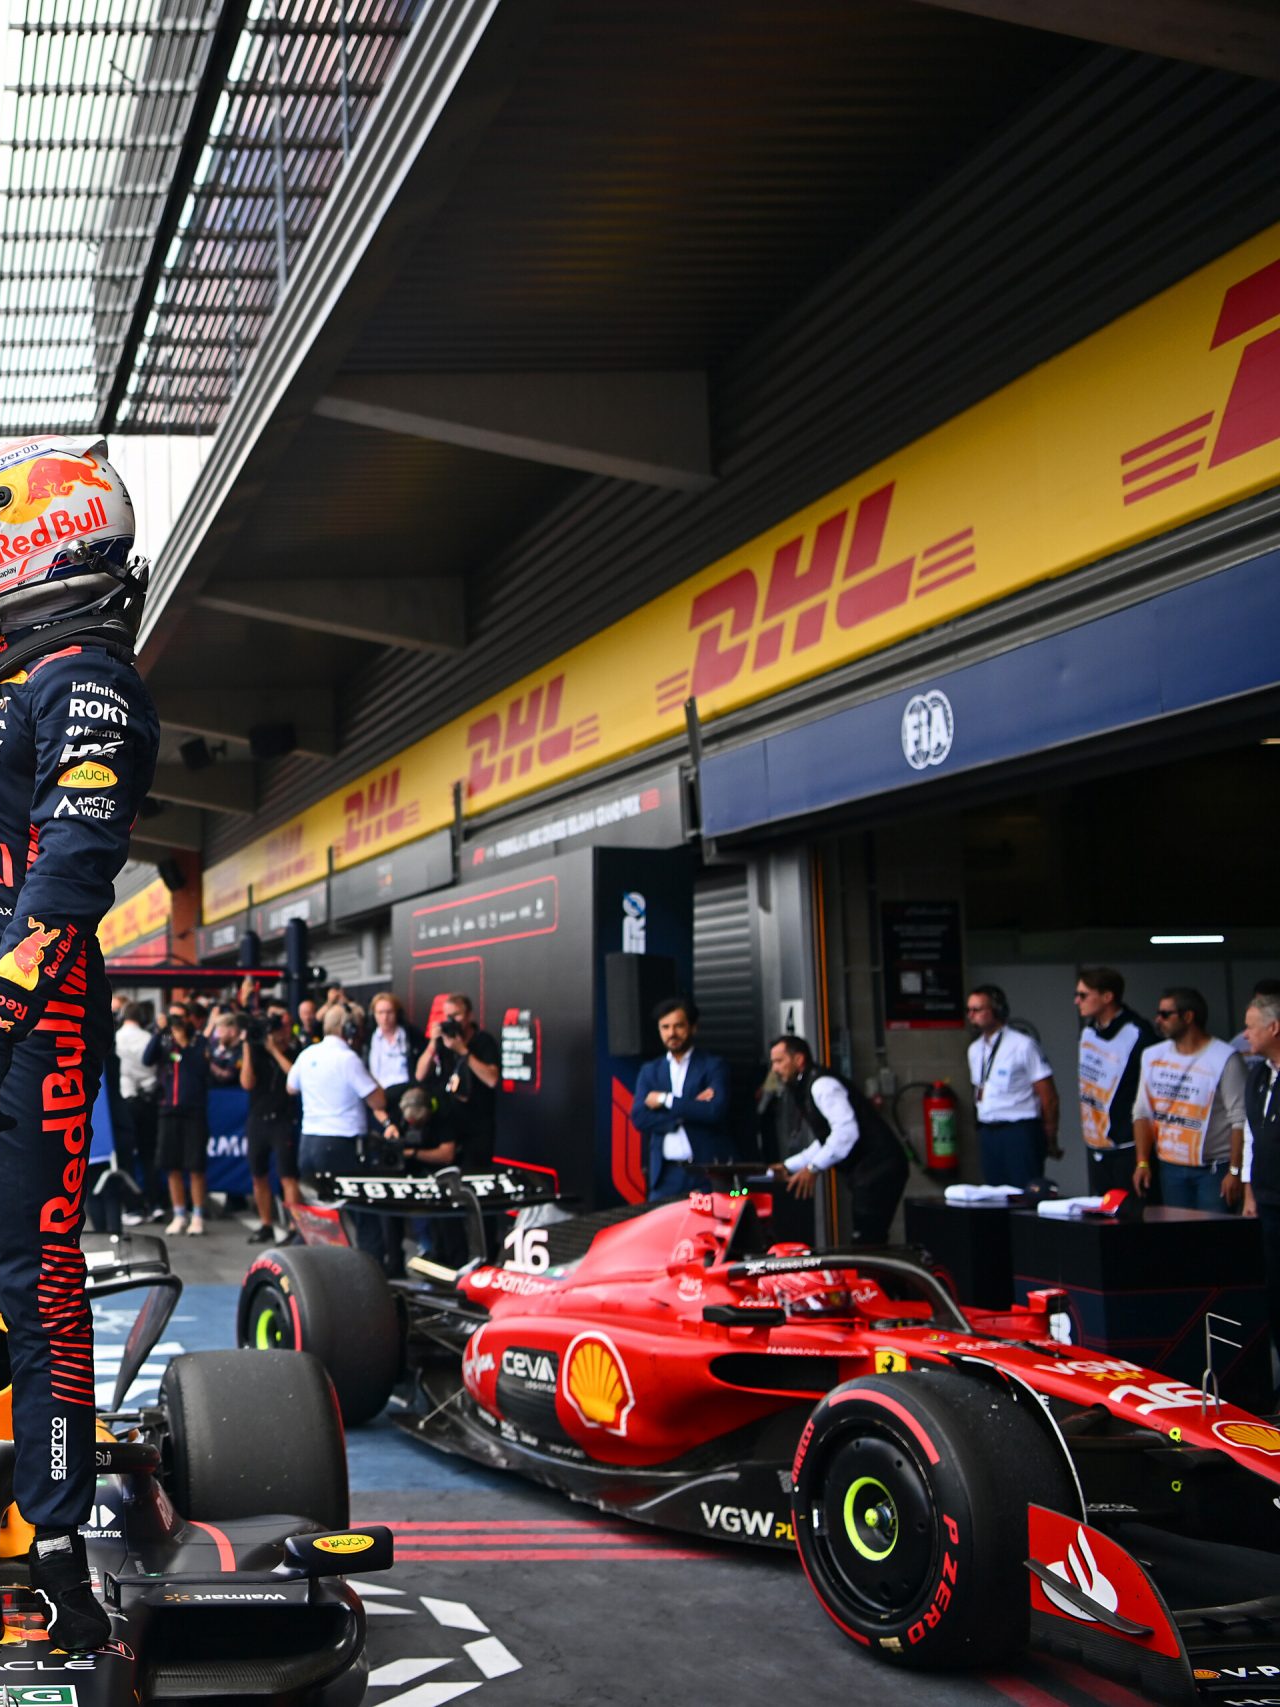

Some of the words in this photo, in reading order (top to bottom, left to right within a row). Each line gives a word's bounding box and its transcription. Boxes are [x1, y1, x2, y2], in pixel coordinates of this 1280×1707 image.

[49, 497, 108, 540] Bull
[688, 480, 917, 698] DHL
[68, 698, 129, 727] ROKT
[71, 681, 129, 709] infinitum
[465, 673, 574, 798] DHL
[71, 770, 110, 783] RAUCH
[75, 796, 116, 811] ARCTIC
[80, 806, 112, 820] WOLF
[343, 767, 404, 852] DHL
[503, 1226, 550, 1276] 16
[1033, 1360, 1144, 1375] VGW
[1108, 1381, 1230, 1416] 16
[50, 1416, 67, 1480] sparco
[700, 1502, 775, 1538] VGW
[775, 1522, 795, 1541] PL
[943, 1514, 960, 1545] P
[330, 1535, 368, 1548] RAUCH
[907, 1552, 958, 1645] ZERO
